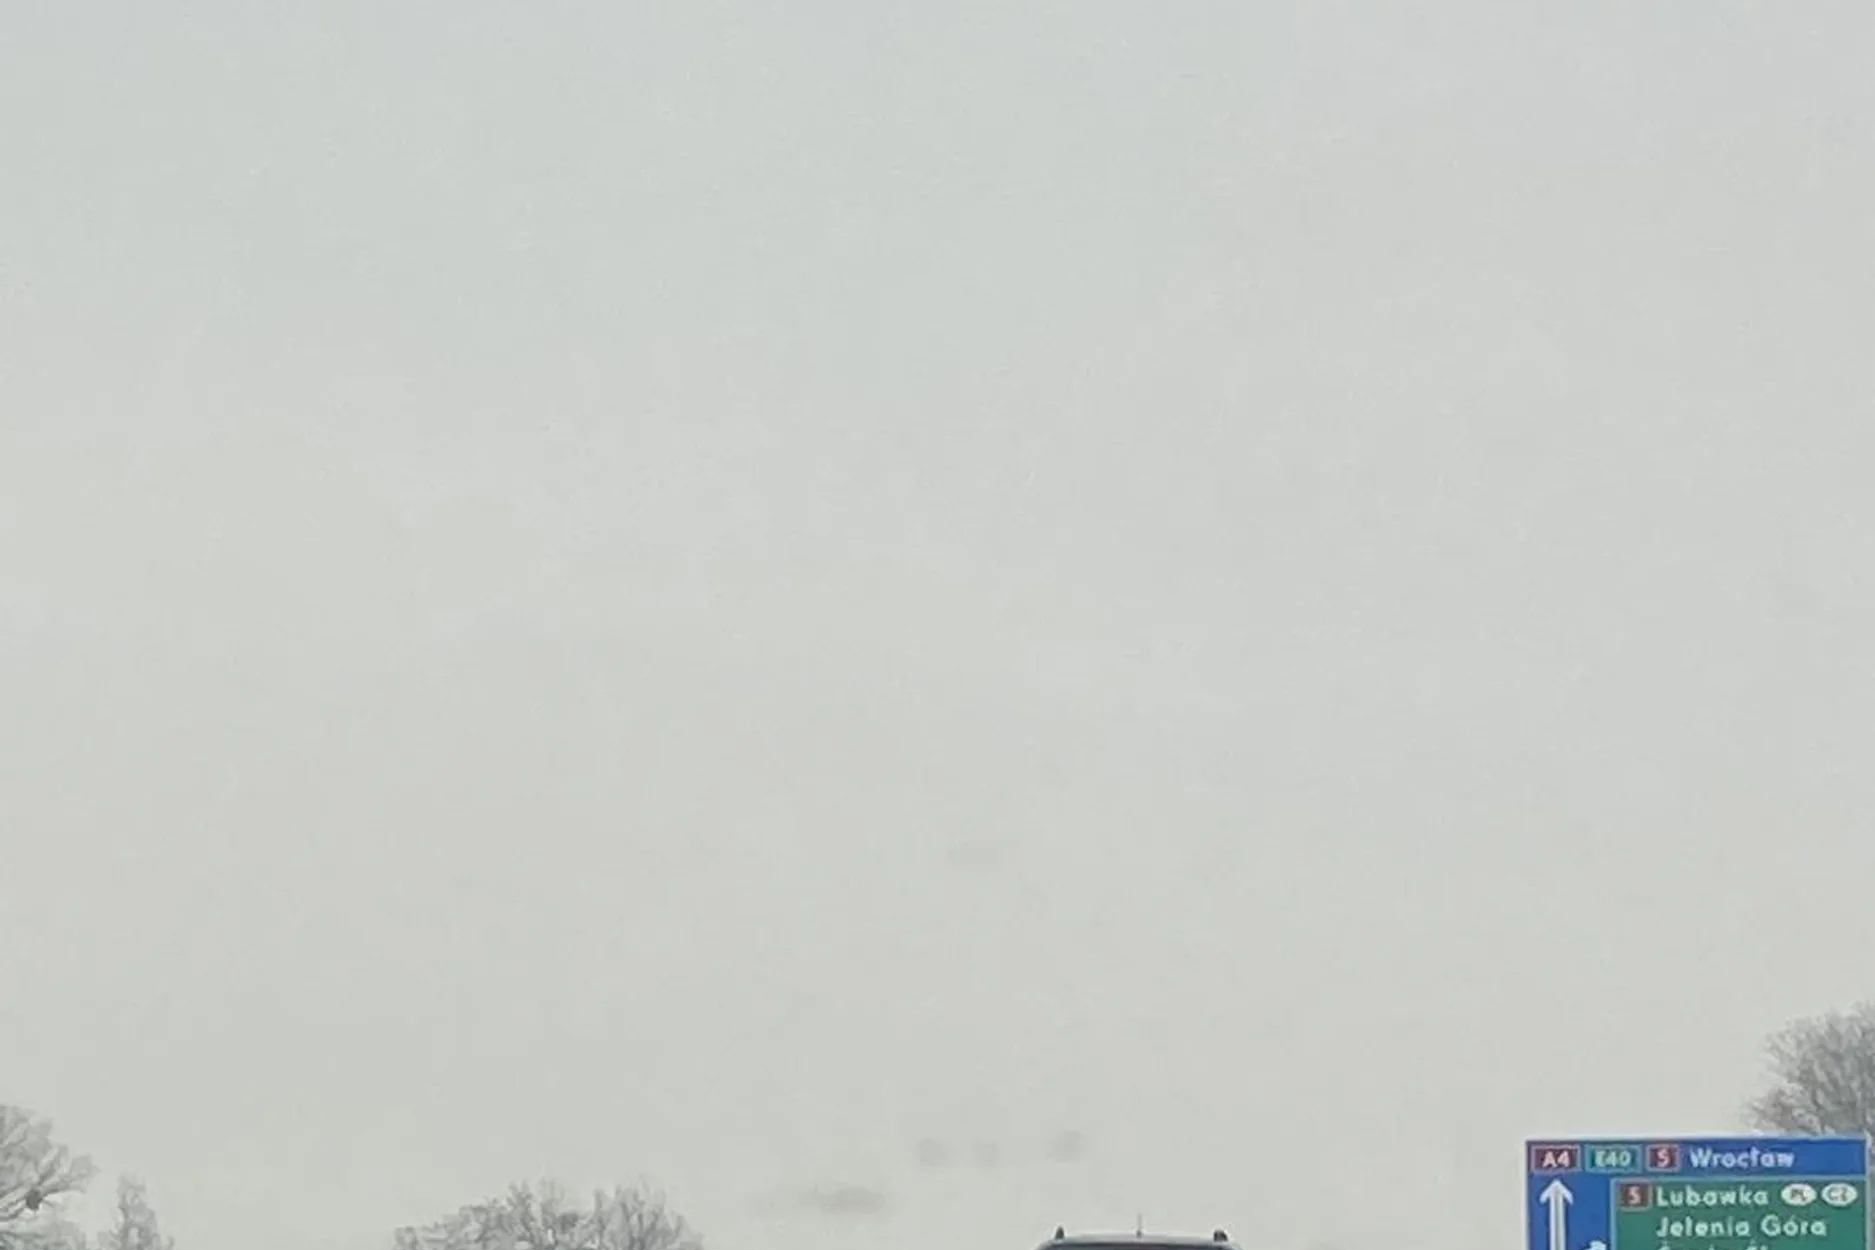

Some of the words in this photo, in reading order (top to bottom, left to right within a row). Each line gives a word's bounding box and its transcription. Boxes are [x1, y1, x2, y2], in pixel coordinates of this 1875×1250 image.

[1542, 1150, 1570, 1168] A4
[1595, 1150, 1632, 1168] E40
[1689, 1145, 1796, 1168] Wrocław
[1656, 1184, 1769, 1206] Lubawka
[1655, 1216, 1750, 1238] Jelenia
[1760, 1212, 1828, 1237] Góra
